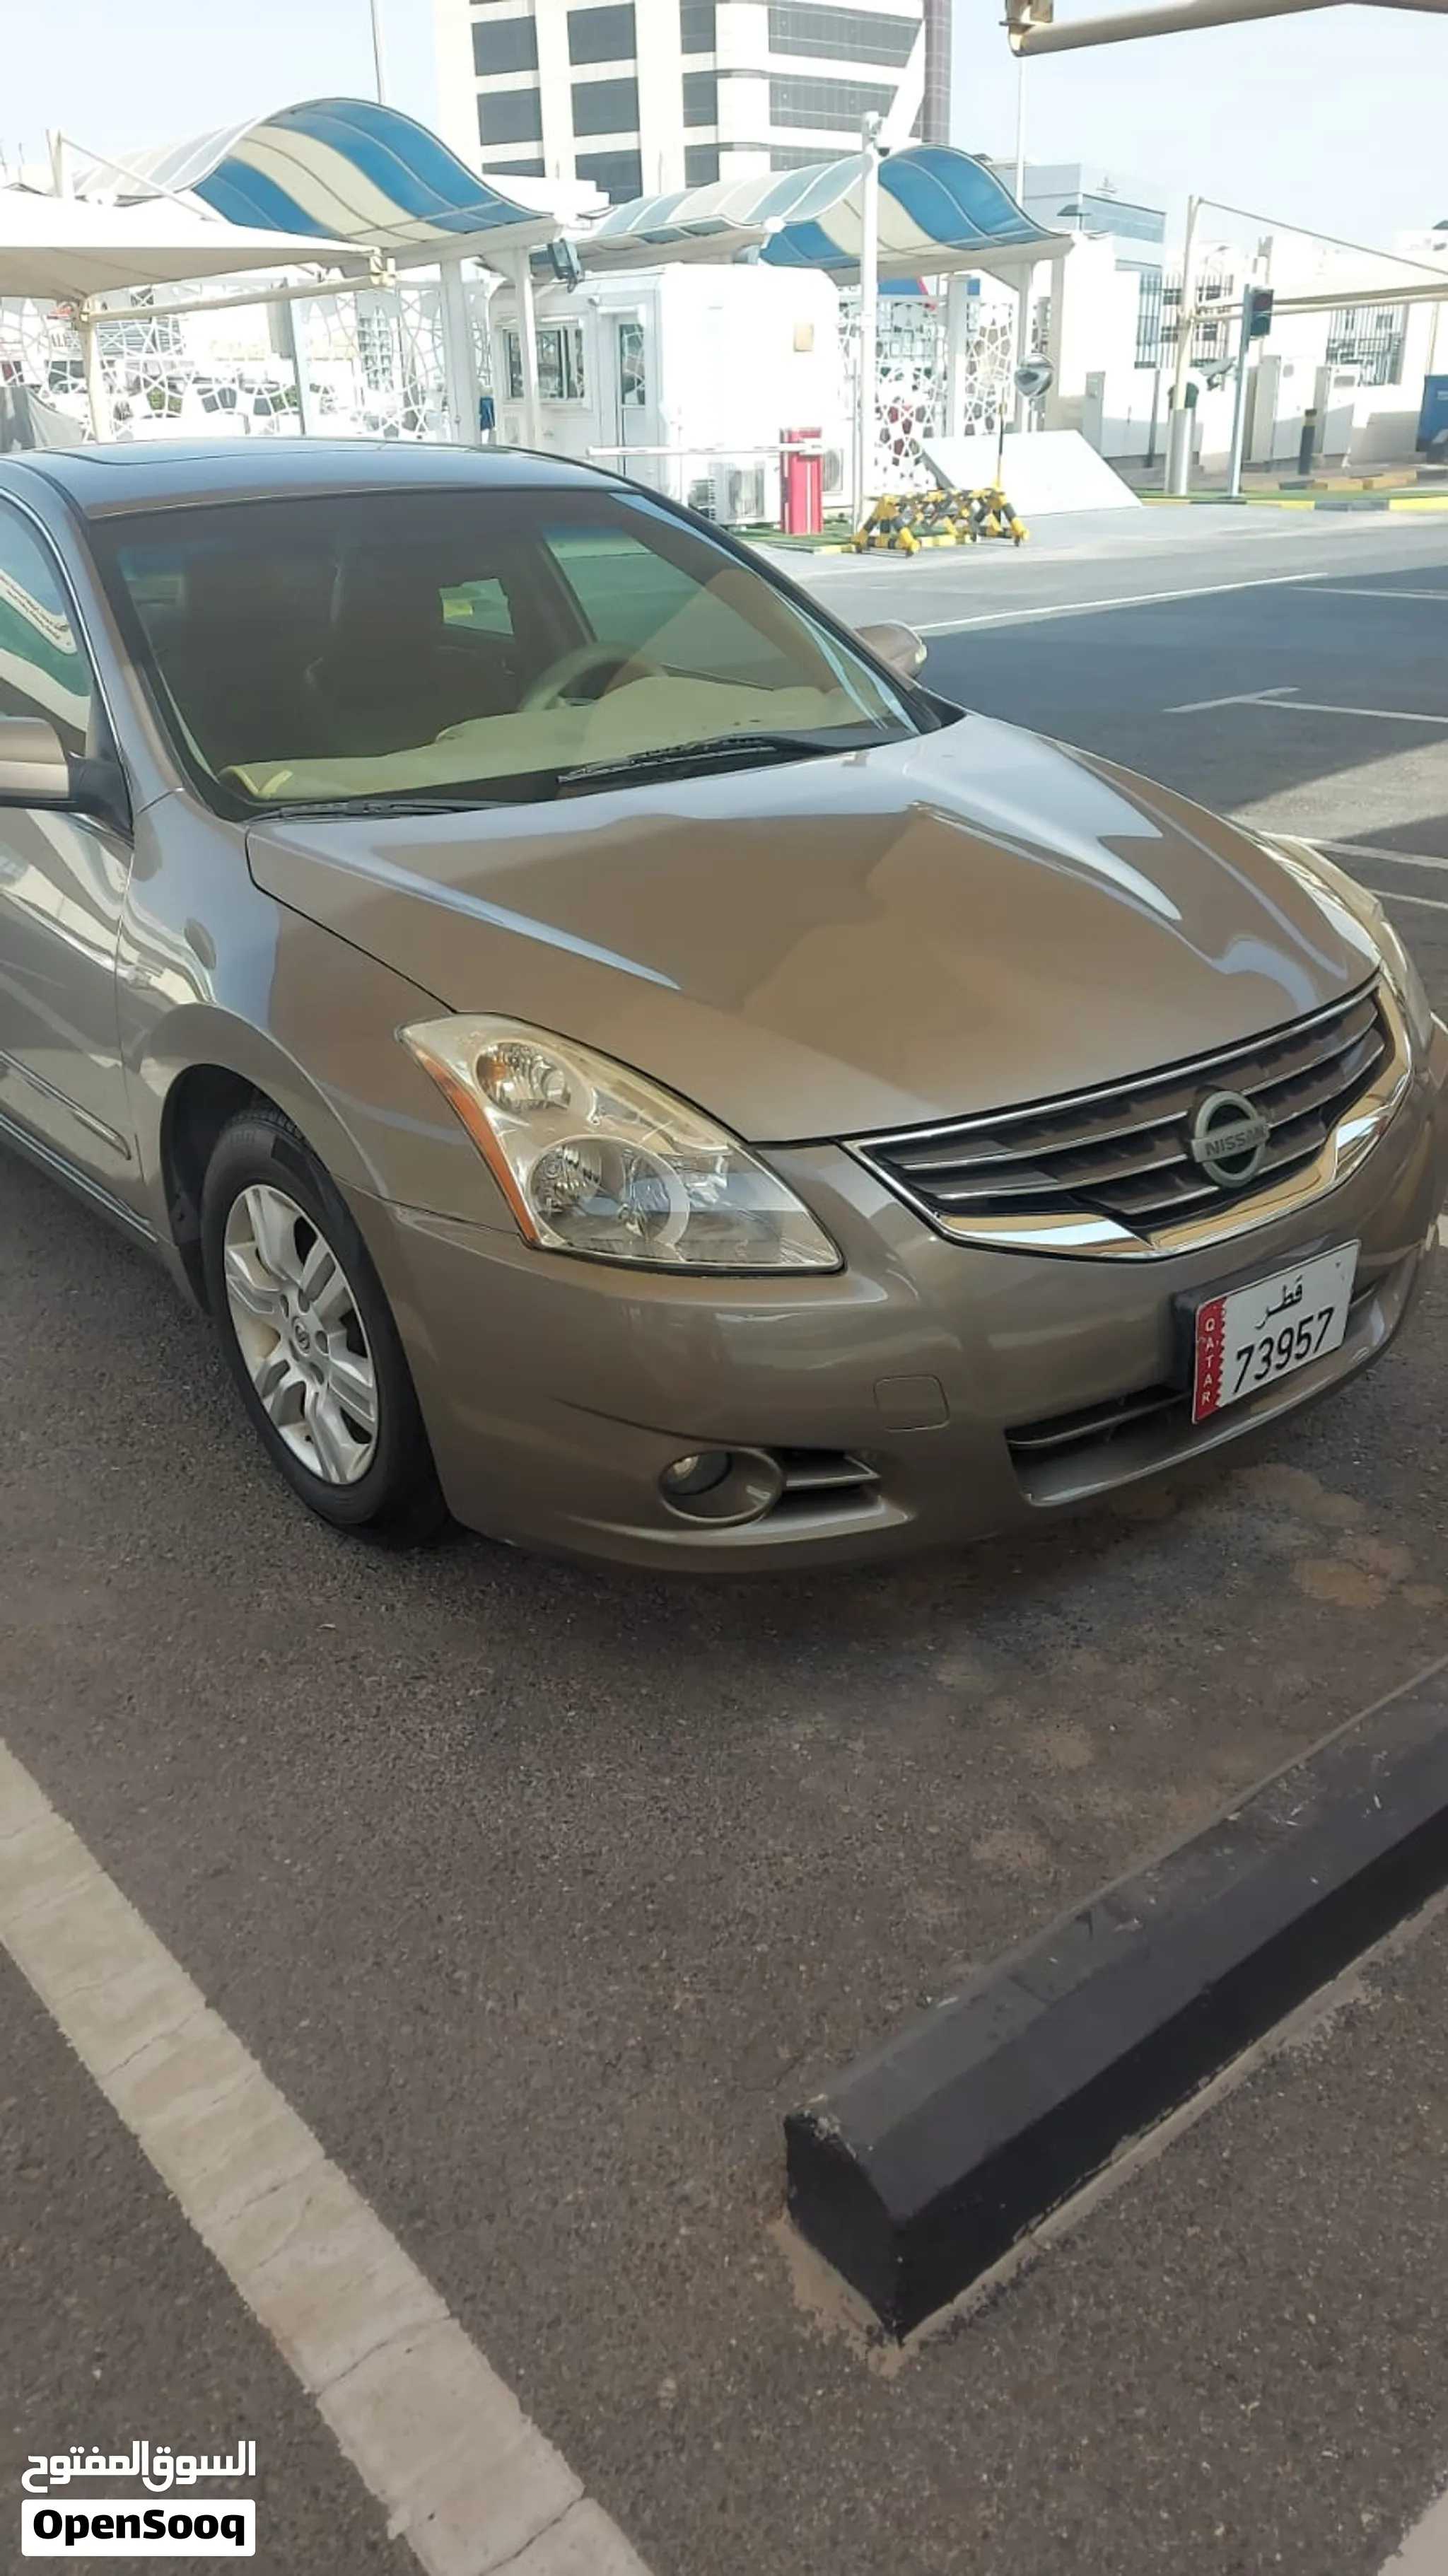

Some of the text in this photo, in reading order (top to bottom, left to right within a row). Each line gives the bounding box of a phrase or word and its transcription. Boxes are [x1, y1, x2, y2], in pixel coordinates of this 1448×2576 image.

[1254, 1274, 1303, 1329] قطر
[1201, 1317, 1215, 1404] QATAR
[1232, 1307, 1335, 1393] 73957
